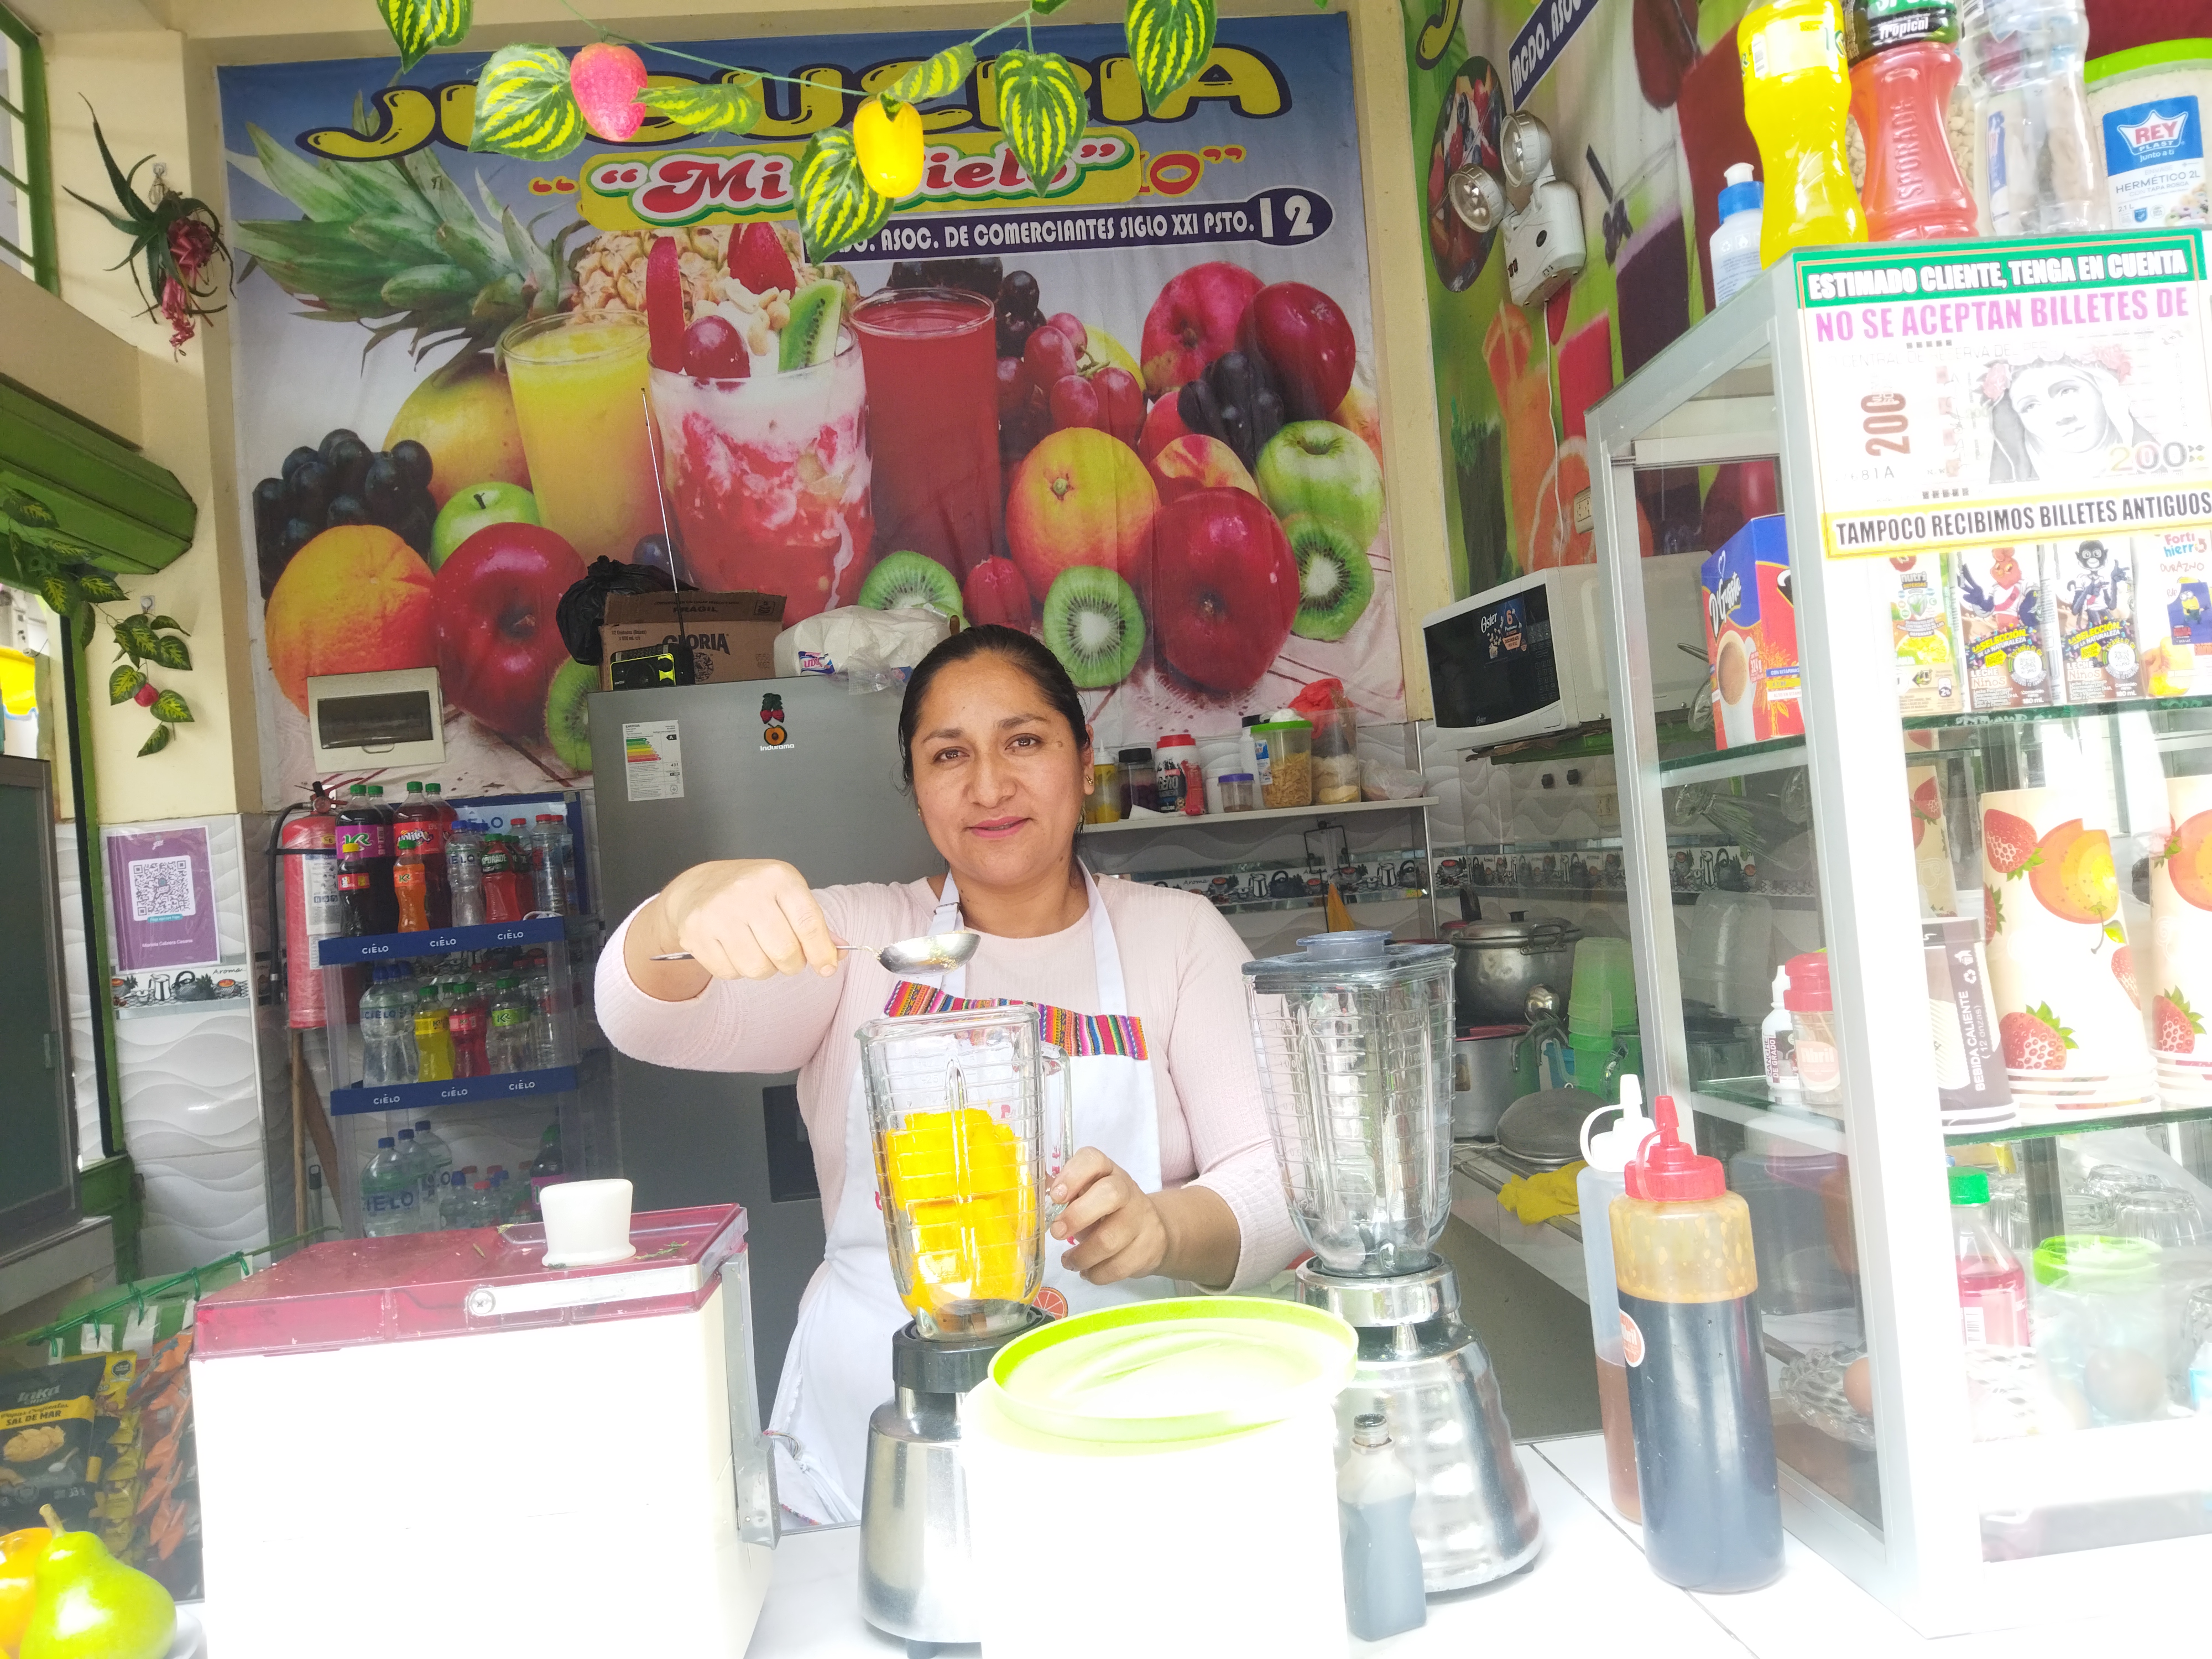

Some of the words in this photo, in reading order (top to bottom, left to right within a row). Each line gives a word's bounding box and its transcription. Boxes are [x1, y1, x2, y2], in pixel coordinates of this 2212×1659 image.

[1879, 17, 1929, 40] Tropical
[1511, 22, 1550, 96] MCDO.
[297, 71, 1294, 161] JUEIA
[2135, 121, 2178, 145] REY
[2139, 140, 2174, 152] PLAST
[2145, 165, 2173, 175] ENVASE
[2116, 171, 2187, 194] HERMÉTICO
[2189, 170, 2201, 179] 2L
[2129, 189, 2145, 197] CON
[2147, 185, 2164, 193] TAPA
[2166, 181, 2189, 189] ROSCA
[881, 227, 939, 251] ASOC.
[944, 225, 969, 248] DE
[974, 217, 1114, 246] COMERCIANTES
[1120, 214, 1168, 239] SIGLO
[1171, 212, 1198, 236] XXI
[1204, 210, 1254, 233] PSTO.
[1808, 266, 1918, 301] ESTIMADO
[1921, 261, 2008, 292] CLIENTE,
[2007, 257, 2074, 287] TENGA
[2078, 253, 2105, 281] EN
[2107, 248, 2188, 279] CUENTA
[1815, 310, 1854, 343] NO
[1863, 306, 1895, 340] SE
[1901, 299, 2024, 337] ACEPTAN
[2031, 288, 2148, 328] BILLETES
[2156, 286, 2189, 319] DE
[1860, 392, 1912, 457] 200
[2109, 441, 2188, 473] 200
[1836, 515, 1927, 546] TAMPOCO
[1932, 507, 2036, 538] RECIBIMOS
[2039, 500, 2118, 529] BILLETES
[2122, 491, 2212, 522] ANTIGUOS
[2164, 531, 2195, 546] Forti
[1901, 571, 1927, 582] nutri
[2159, 560, 2205, 572] DURAZNO
[1481, 612, 1498, 634] Oster
[1506, 609, 1513, 625] 6
[1979, 628, 2027, 649] SELECCIÓN
[2075, 620, 2121, 642] SELECCIÓN
[2086, 629, 2120, 645] NATURALEZA
[1990, 637, 2027, 653] NATURALEZA
[1971, 668, 1999, 677] LECHE
[2067, 661, 2094, 670] LECHE
[1476, 716, 1486, 725] Oster
[481, 854, 508, 865] SPORADE
[1182, 878, 1211, 886] Aroma
[1958, 990, 1978, 1047] CALIENTE
[1974, 1005, 1986, 1038] onzas)
[1763, 1036, 1772, 1078] SANGRE
[1769, 1039, 1778, 1066] GRADO
[1773, 1066, 1780, 1078] DE
[1969, 1048, 1986, 1092] BEBIDA
[17, 1385, 60, 1403] Inka
[6, 1417, 23, 1426] SAL
[25, 1413, 38, 1423] DE
[40, 1410, 62, 1420] MAR
